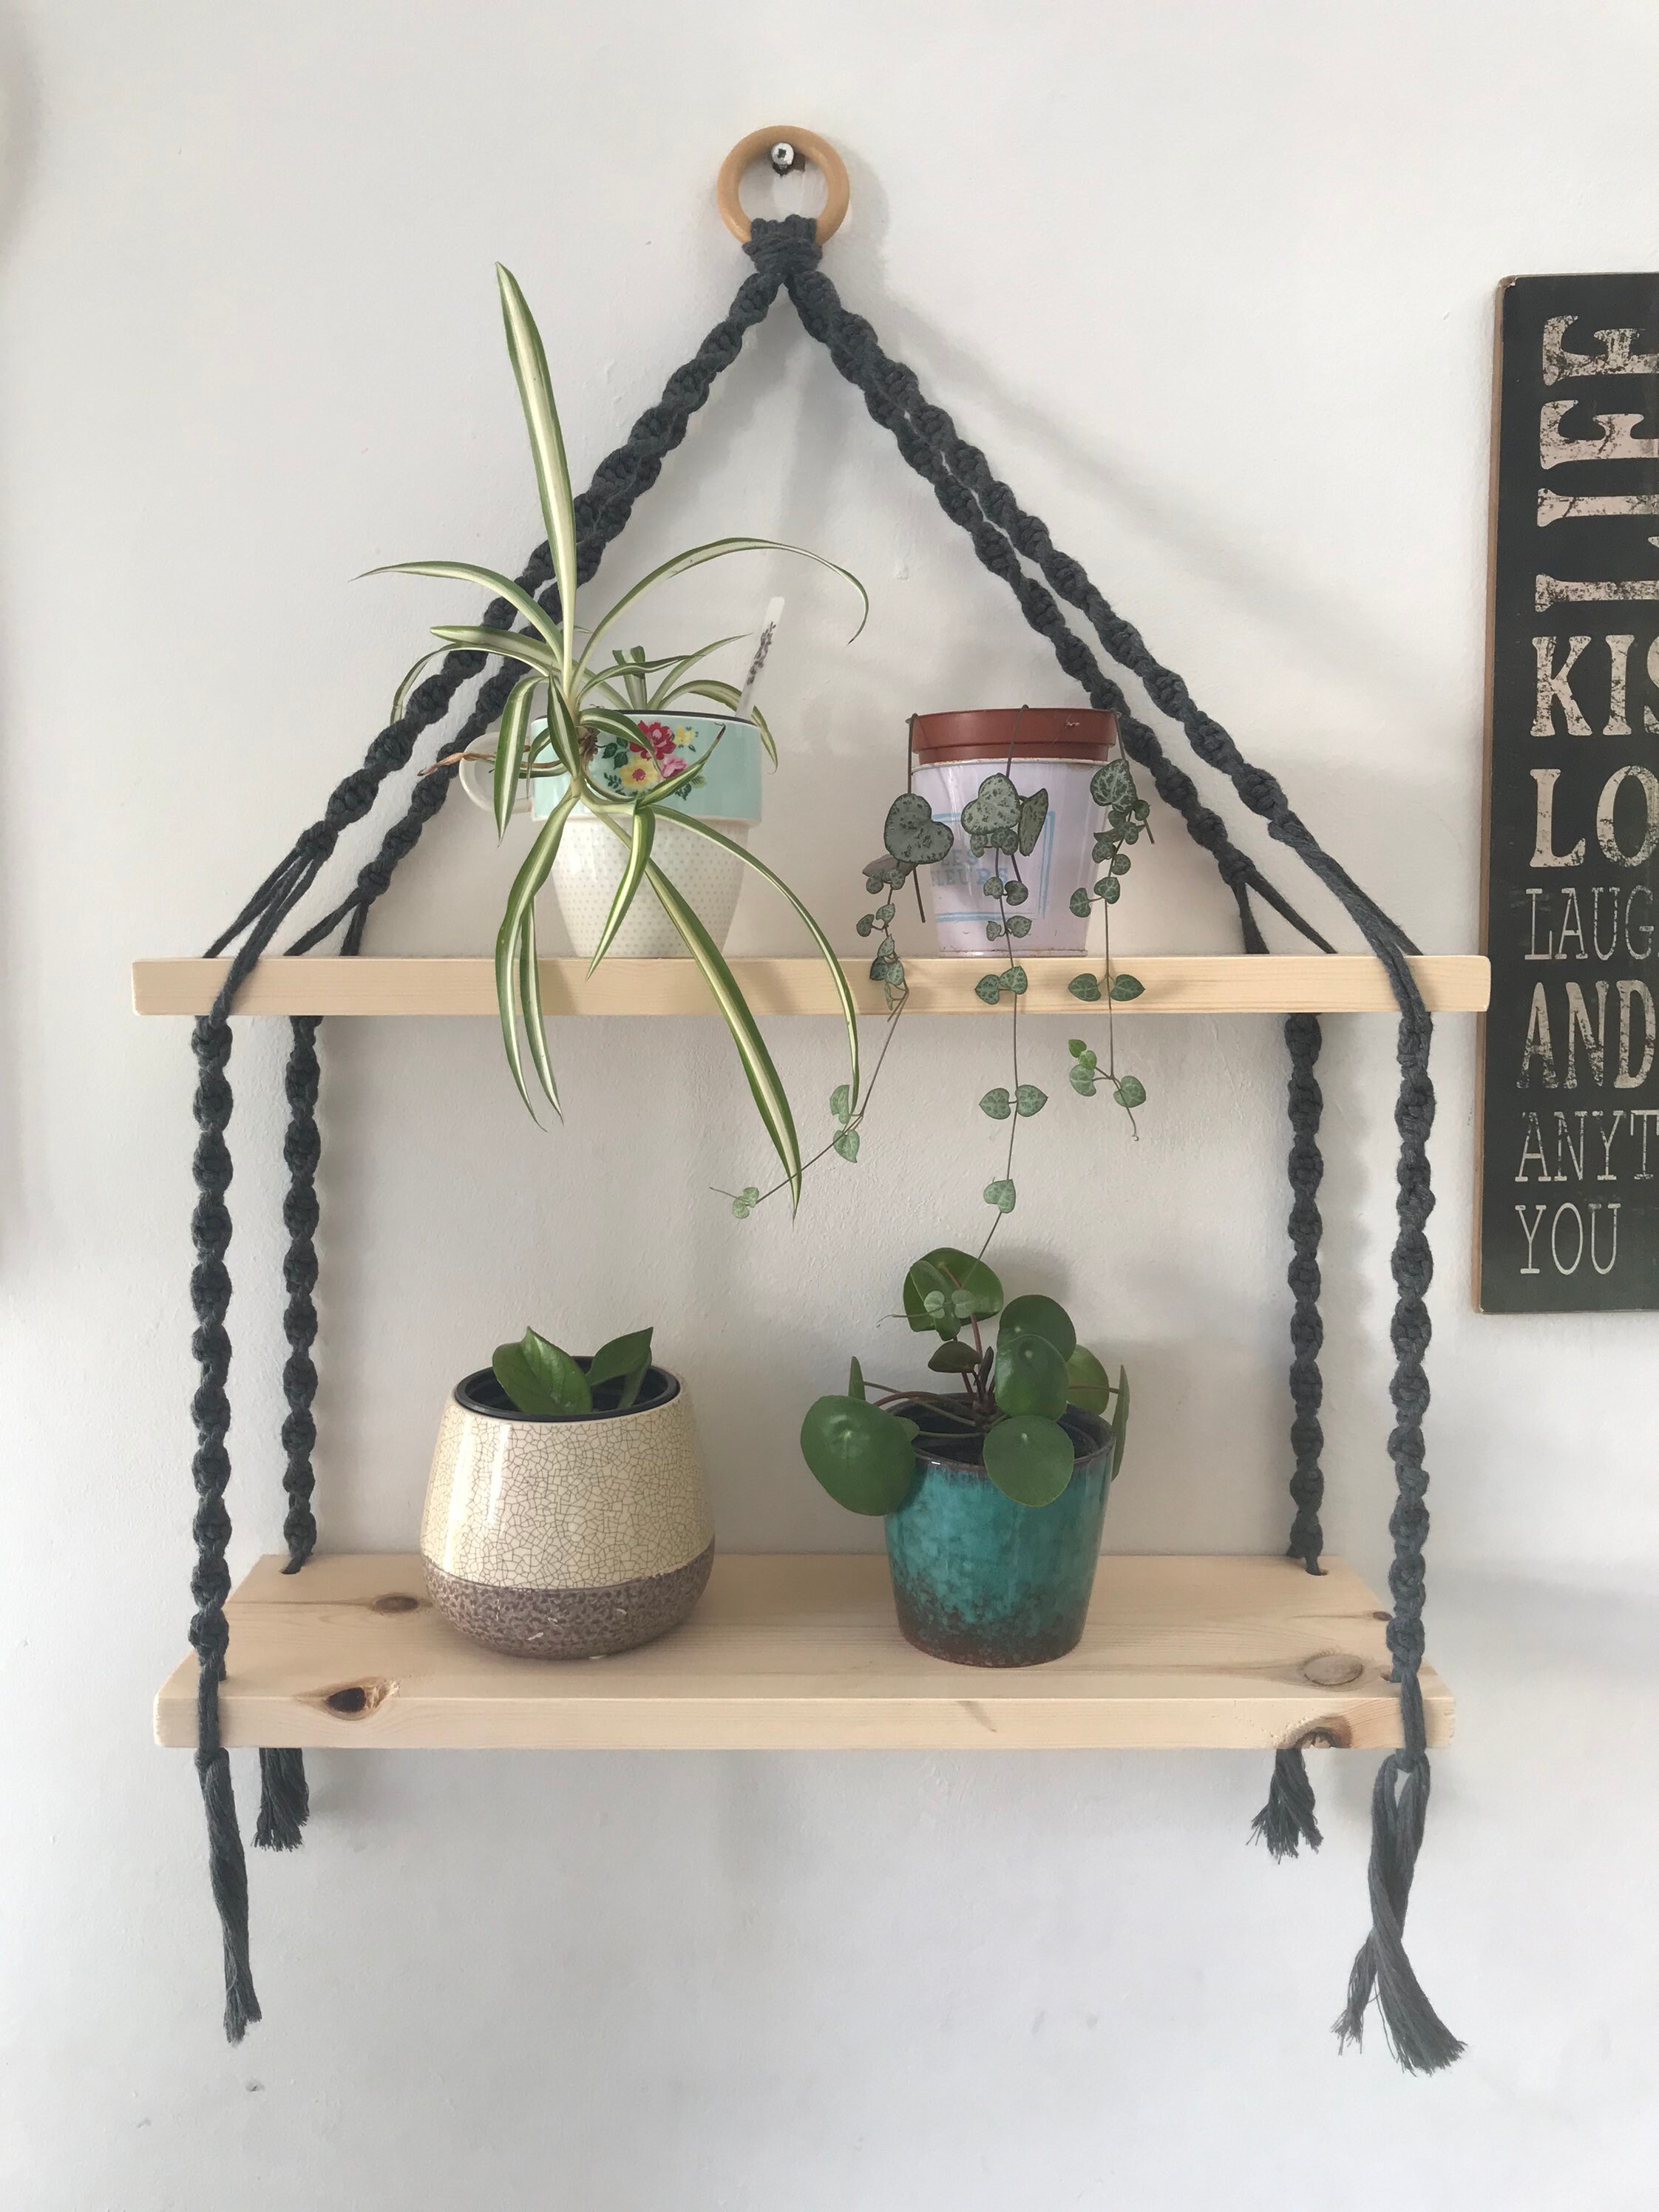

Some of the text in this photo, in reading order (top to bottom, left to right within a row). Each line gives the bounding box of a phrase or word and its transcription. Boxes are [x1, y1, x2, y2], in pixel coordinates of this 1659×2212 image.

[1524, 885, 1659, 960] LAUG
[1517, 980, 1656, 1089] AND
[1515, 1110, 1659, 1181] ANYT
[1515, 1203, 1621, 1275] YOU
